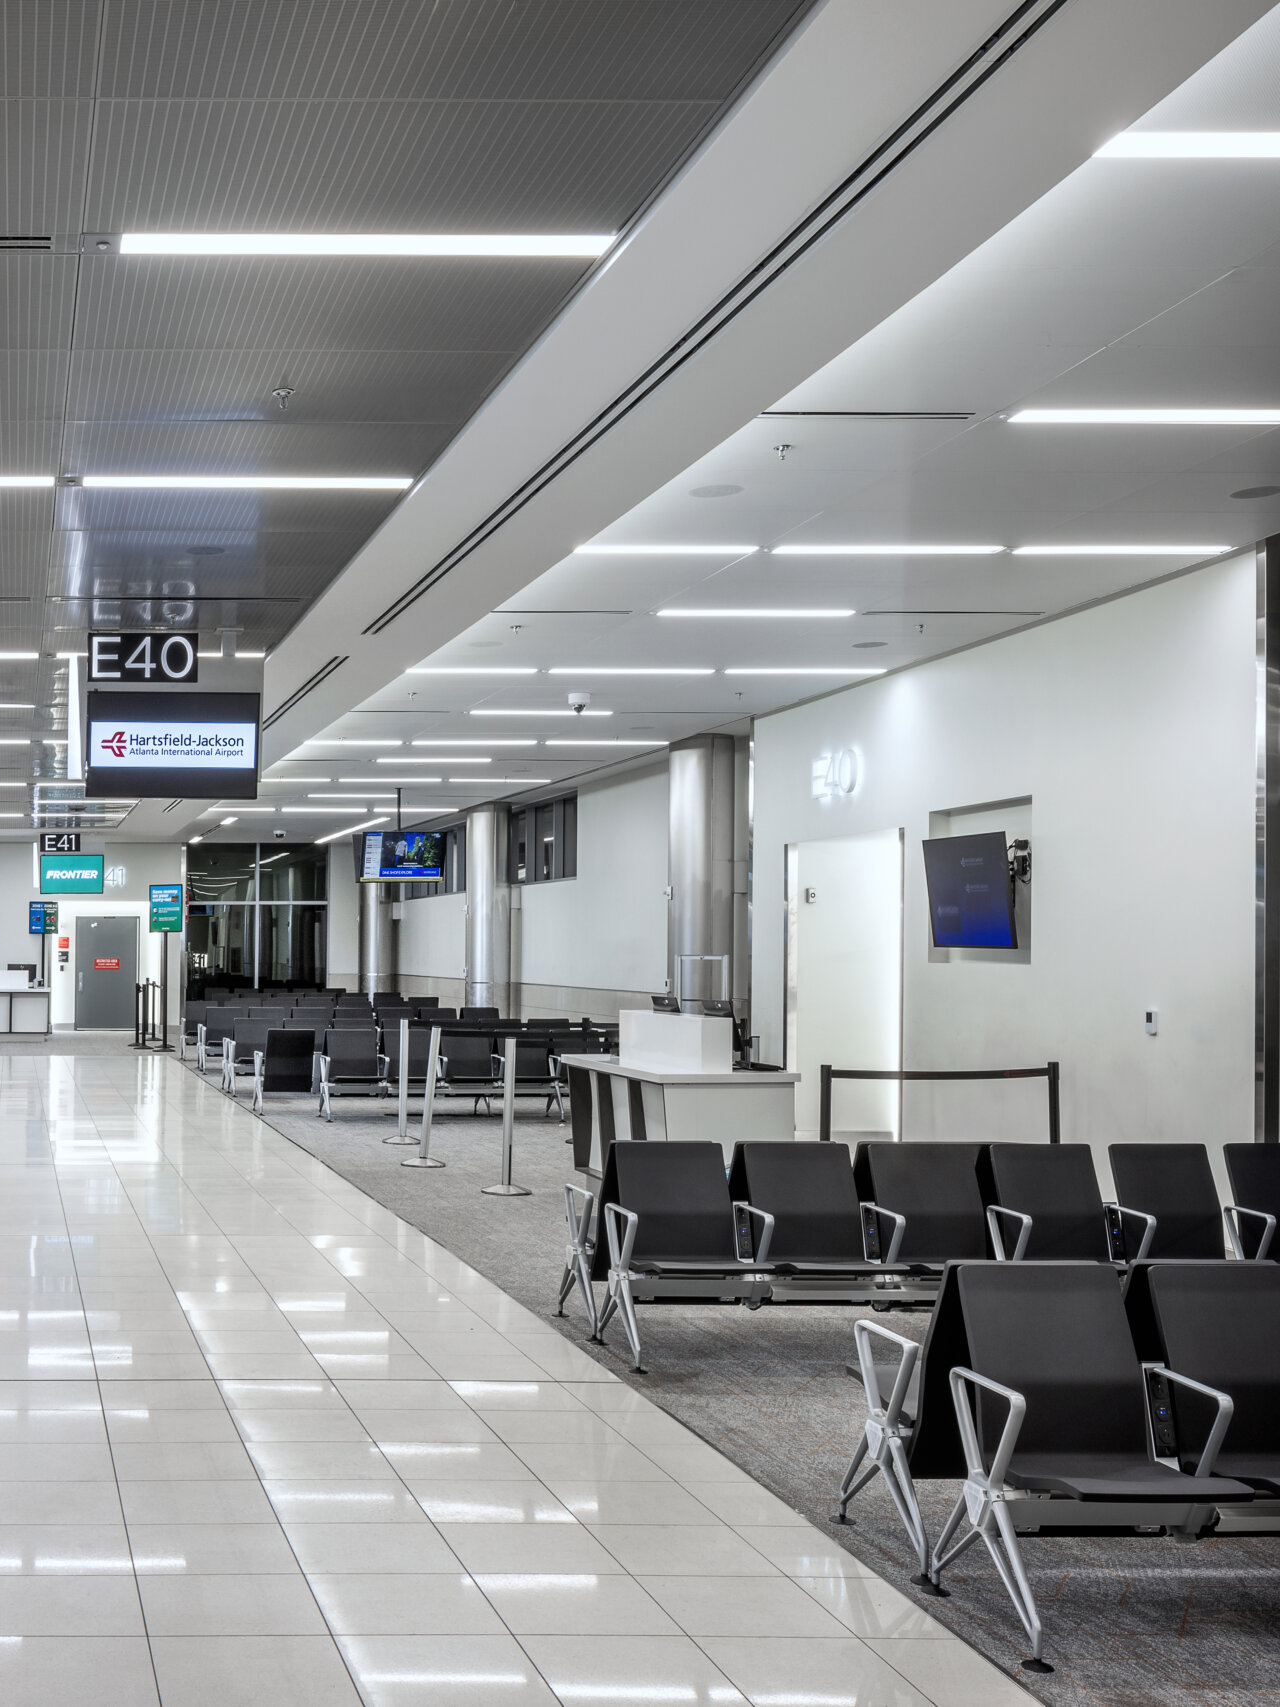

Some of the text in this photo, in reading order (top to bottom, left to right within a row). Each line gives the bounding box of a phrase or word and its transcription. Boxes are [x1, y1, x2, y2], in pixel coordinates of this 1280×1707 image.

[92, 635, 194, 679] E40
[129, 733, 244, 747] Hartsfield-Jackson
[129, 747, 244, 758] Atlanta International Airport
[810, 748, 858, 800] E40
[45, 834, 76, 851] E41
[45, 870, 98, 880] FRONTIER
